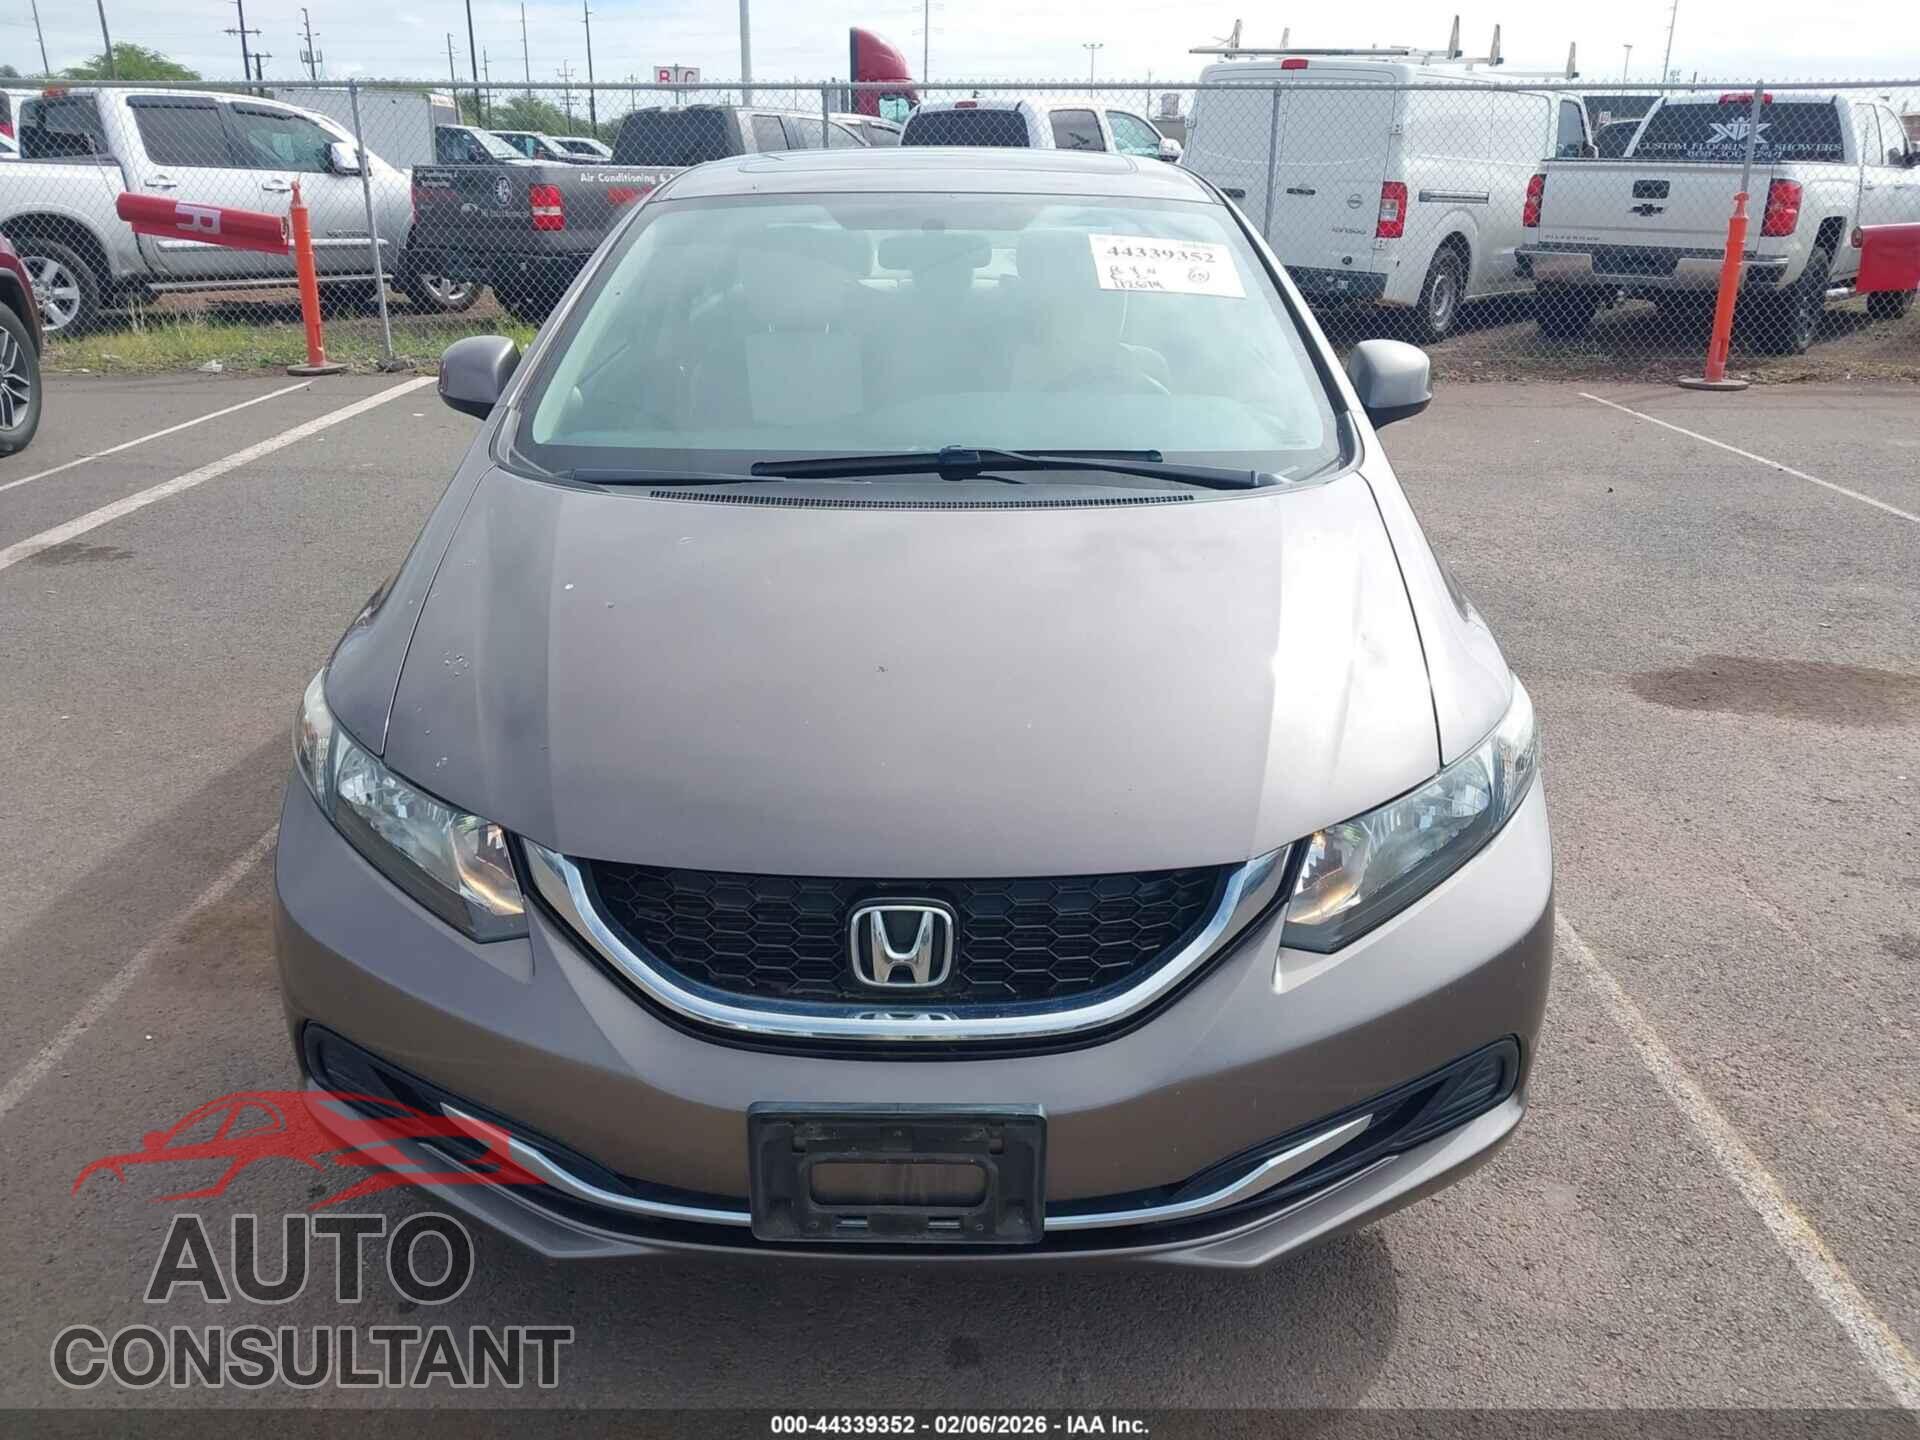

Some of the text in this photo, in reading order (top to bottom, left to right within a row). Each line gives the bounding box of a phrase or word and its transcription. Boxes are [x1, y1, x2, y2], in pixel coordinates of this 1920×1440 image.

[1637, 142, 1687, 151] CUSTOM
[1691, 142, 1756, 152] FLOORIN
[1774, 142, 1843, 152] SHOWERS
[580, 172, 594, 182] Air
[598, 172, 657, 185] Conditioning
[1106, 245, 1217, 264] 44339352
